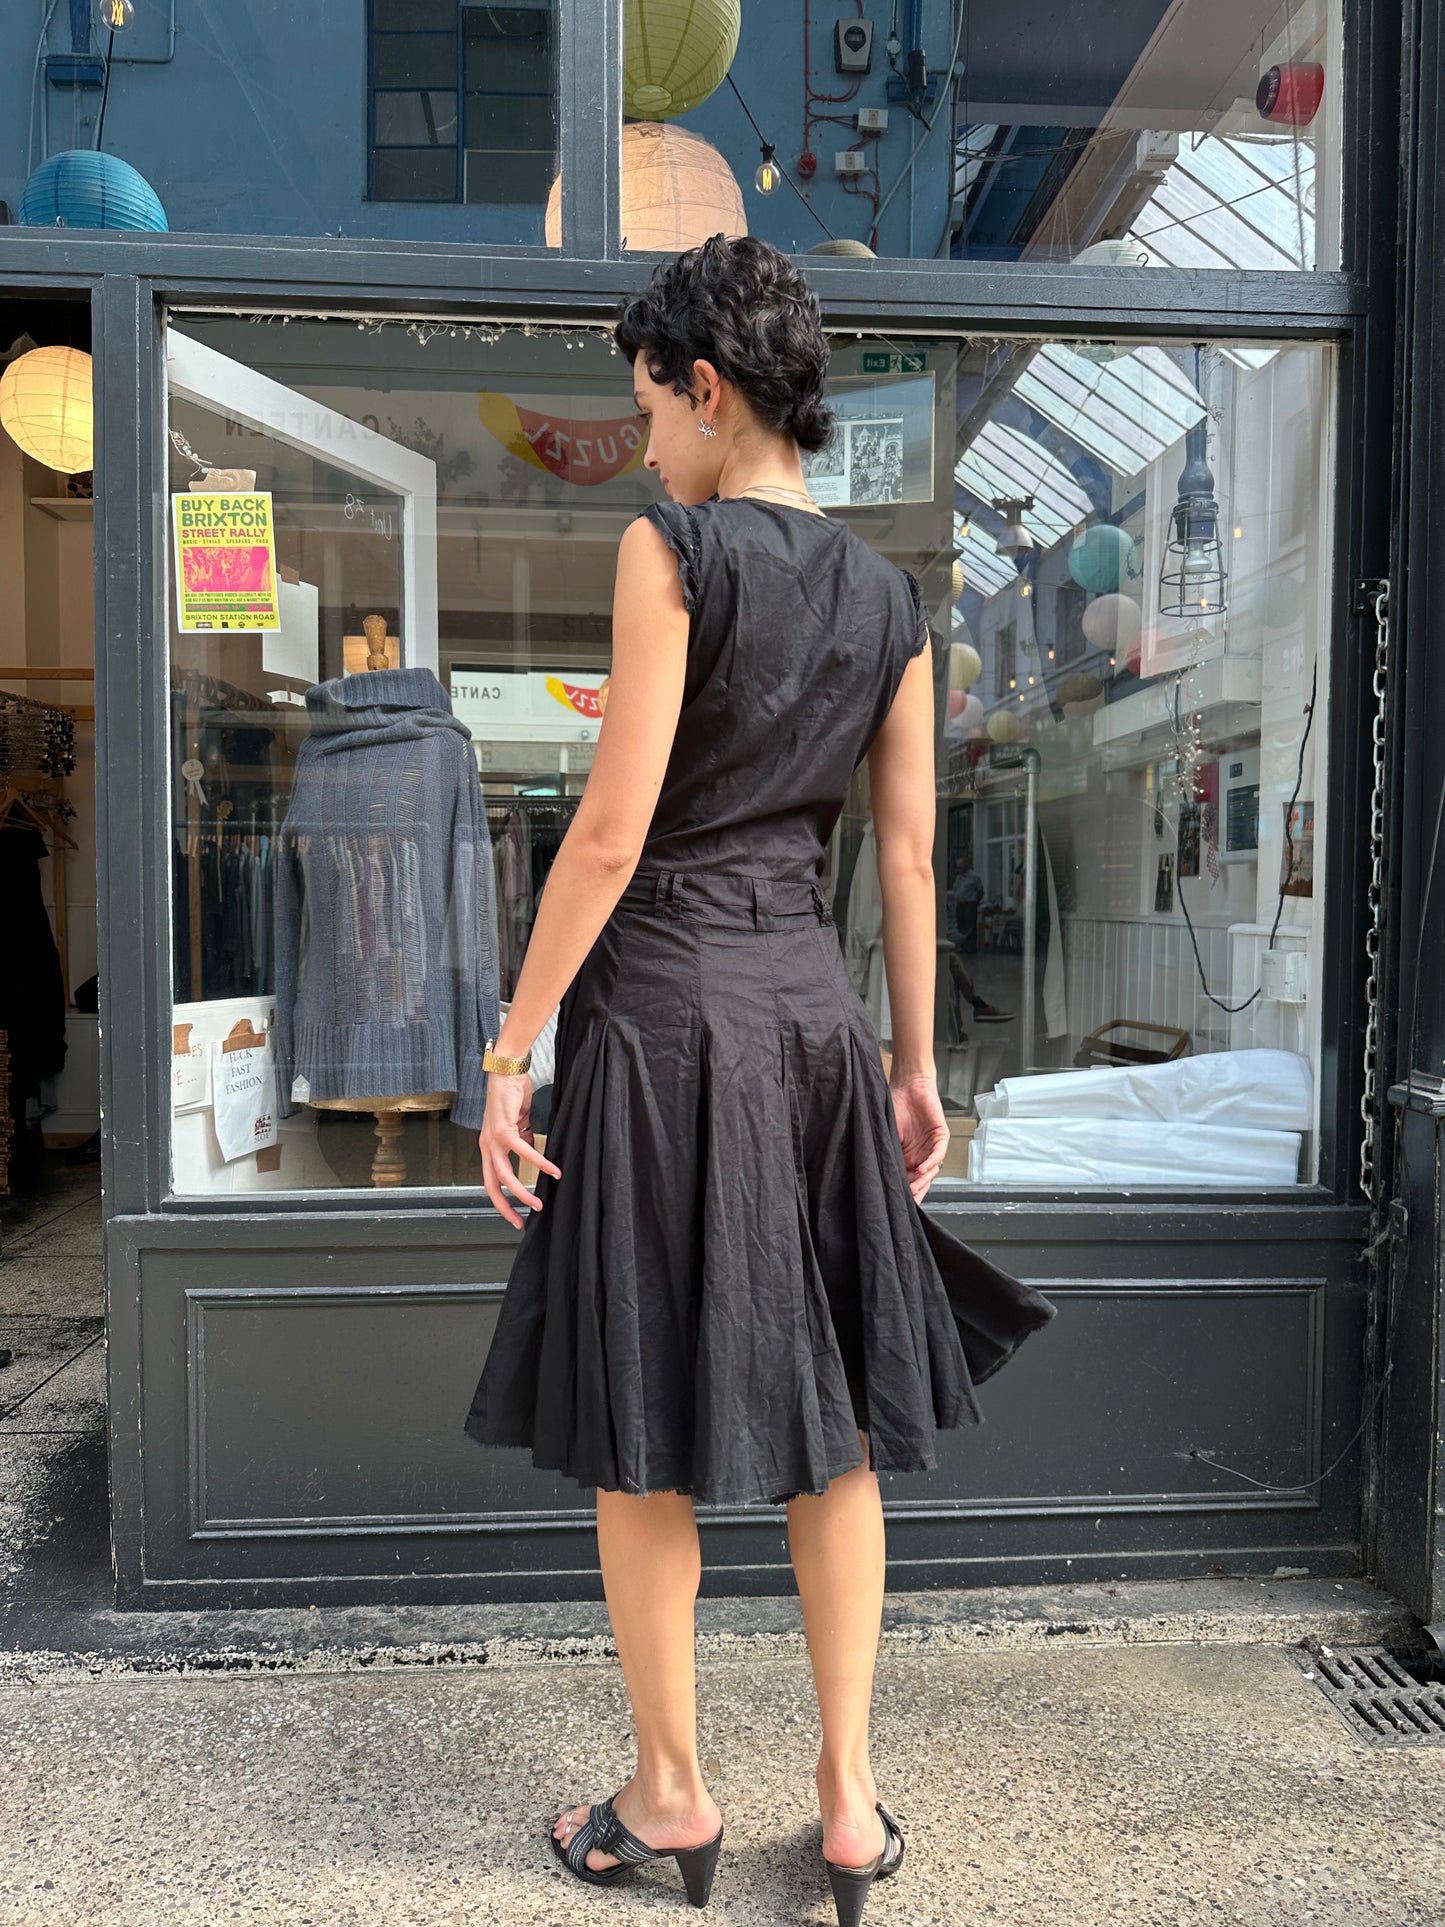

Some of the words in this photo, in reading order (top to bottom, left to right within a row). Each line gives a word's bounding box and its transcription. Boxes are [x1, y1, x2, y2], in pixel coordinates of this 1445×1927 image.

[181, 500, 214, 511] BUY
[220, 499, 266, 511] BACK
[182, 512, 267, 527] BRIXTON
[182, 529, 226, 538] STREET
[229, 528, 266, 538] RALLY
[231, 1063, 252, 1078] FAST
[225, 1075, 264, 1095] FASHION
